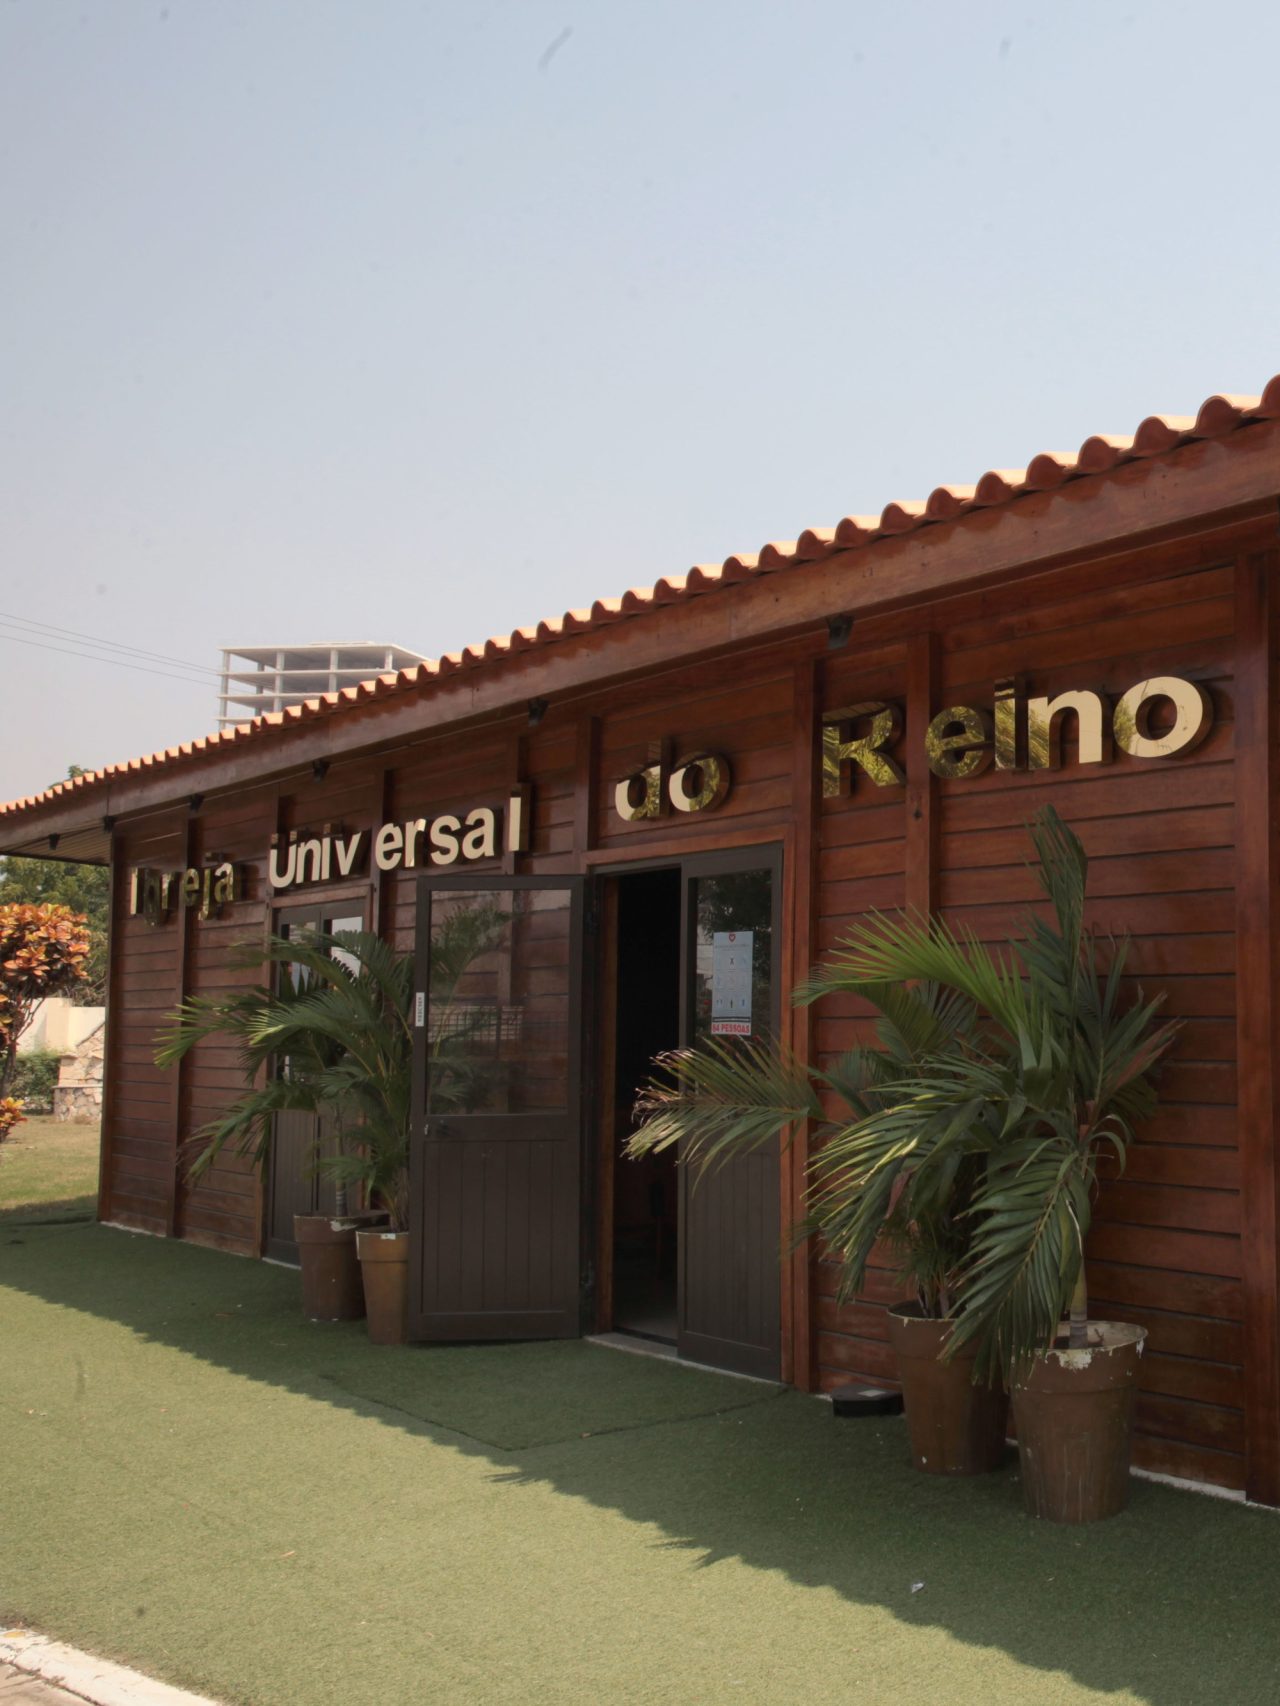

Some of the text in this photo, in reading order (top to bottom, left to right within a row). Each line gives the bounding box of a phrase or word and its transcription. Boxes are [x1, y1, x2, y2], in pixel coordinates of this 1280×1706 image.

[269, 791, 522, 888] Universal
[615, 739, 724, 821] do
[822, 676, 1203, 799] Reino
